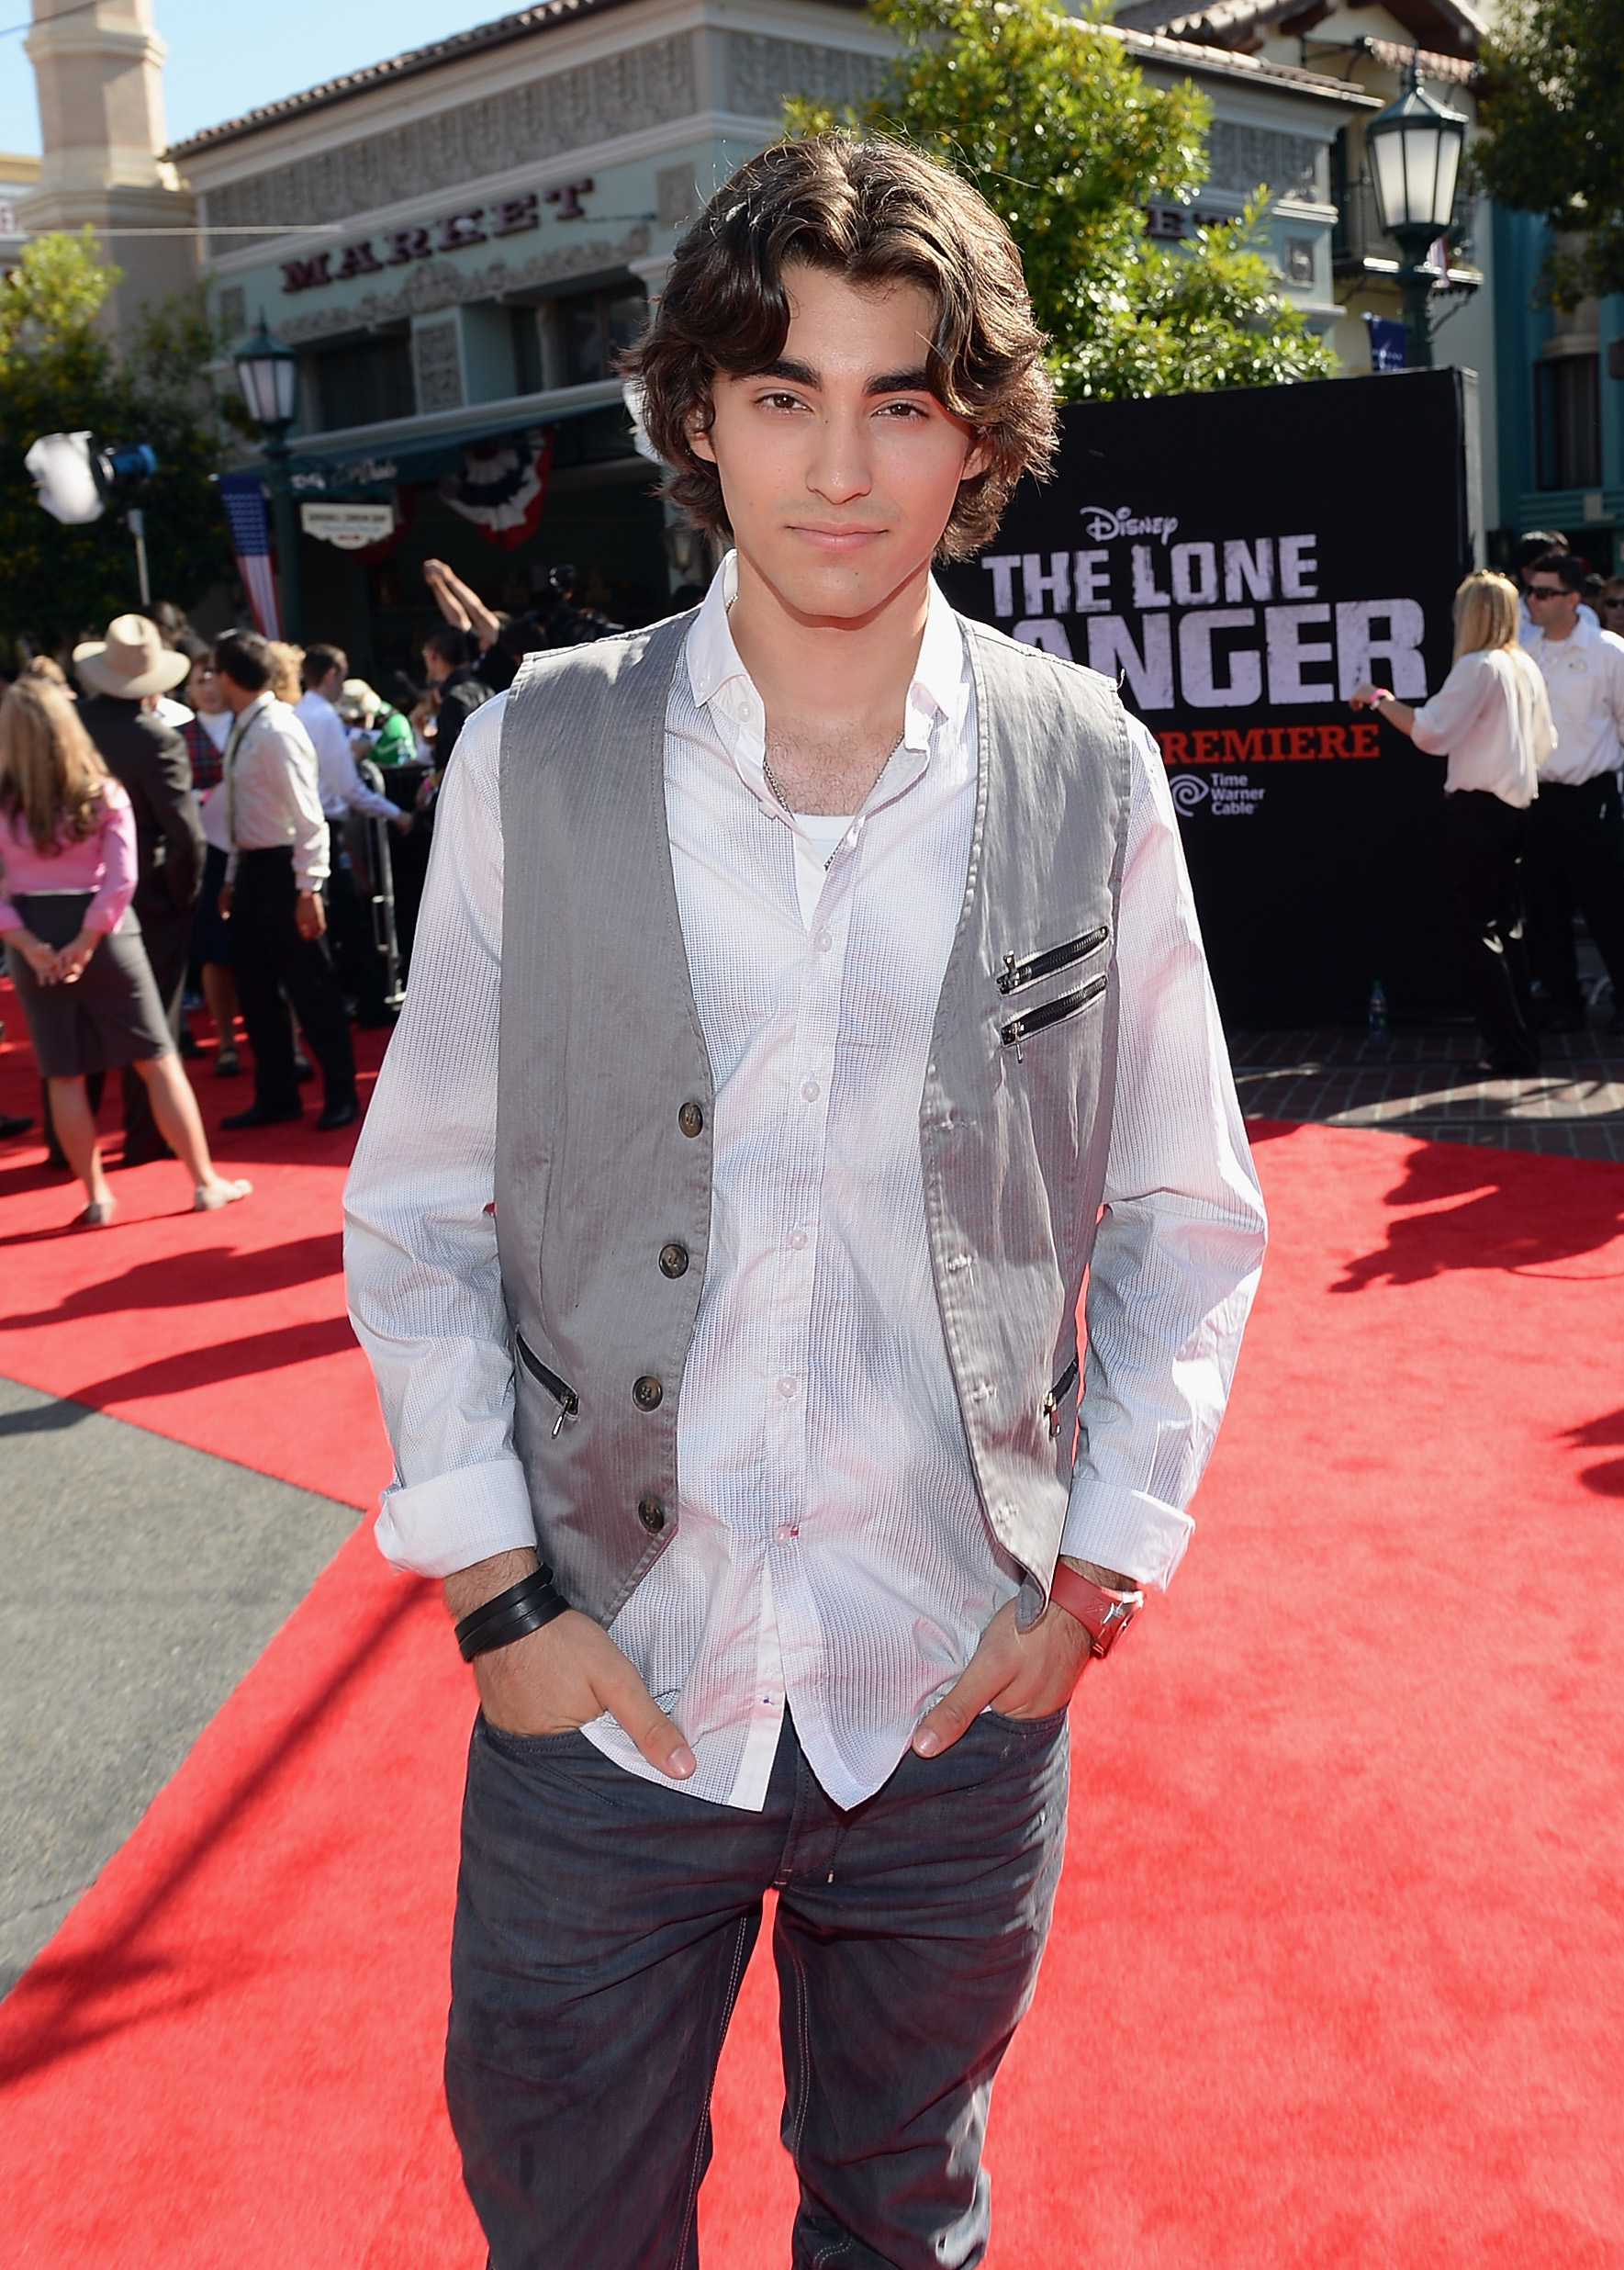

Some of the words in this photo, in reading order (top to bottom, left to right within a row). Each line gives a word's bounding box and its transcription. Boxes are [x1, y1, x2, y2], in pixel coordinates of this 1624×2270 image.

[281, 178, 593, 292] MARKET
[1080, 506, 1179, 545] Disney
[981, 549, 1113, 617] THE
[1131, 534, 1319, 608] LONE
[1153, 724, 1380, 765] REMIERE
[1211, 772, 1249, 787] Time
[1211, 788, 1266, 801] Warner
[1211, 801, 1255, 815] Cable
